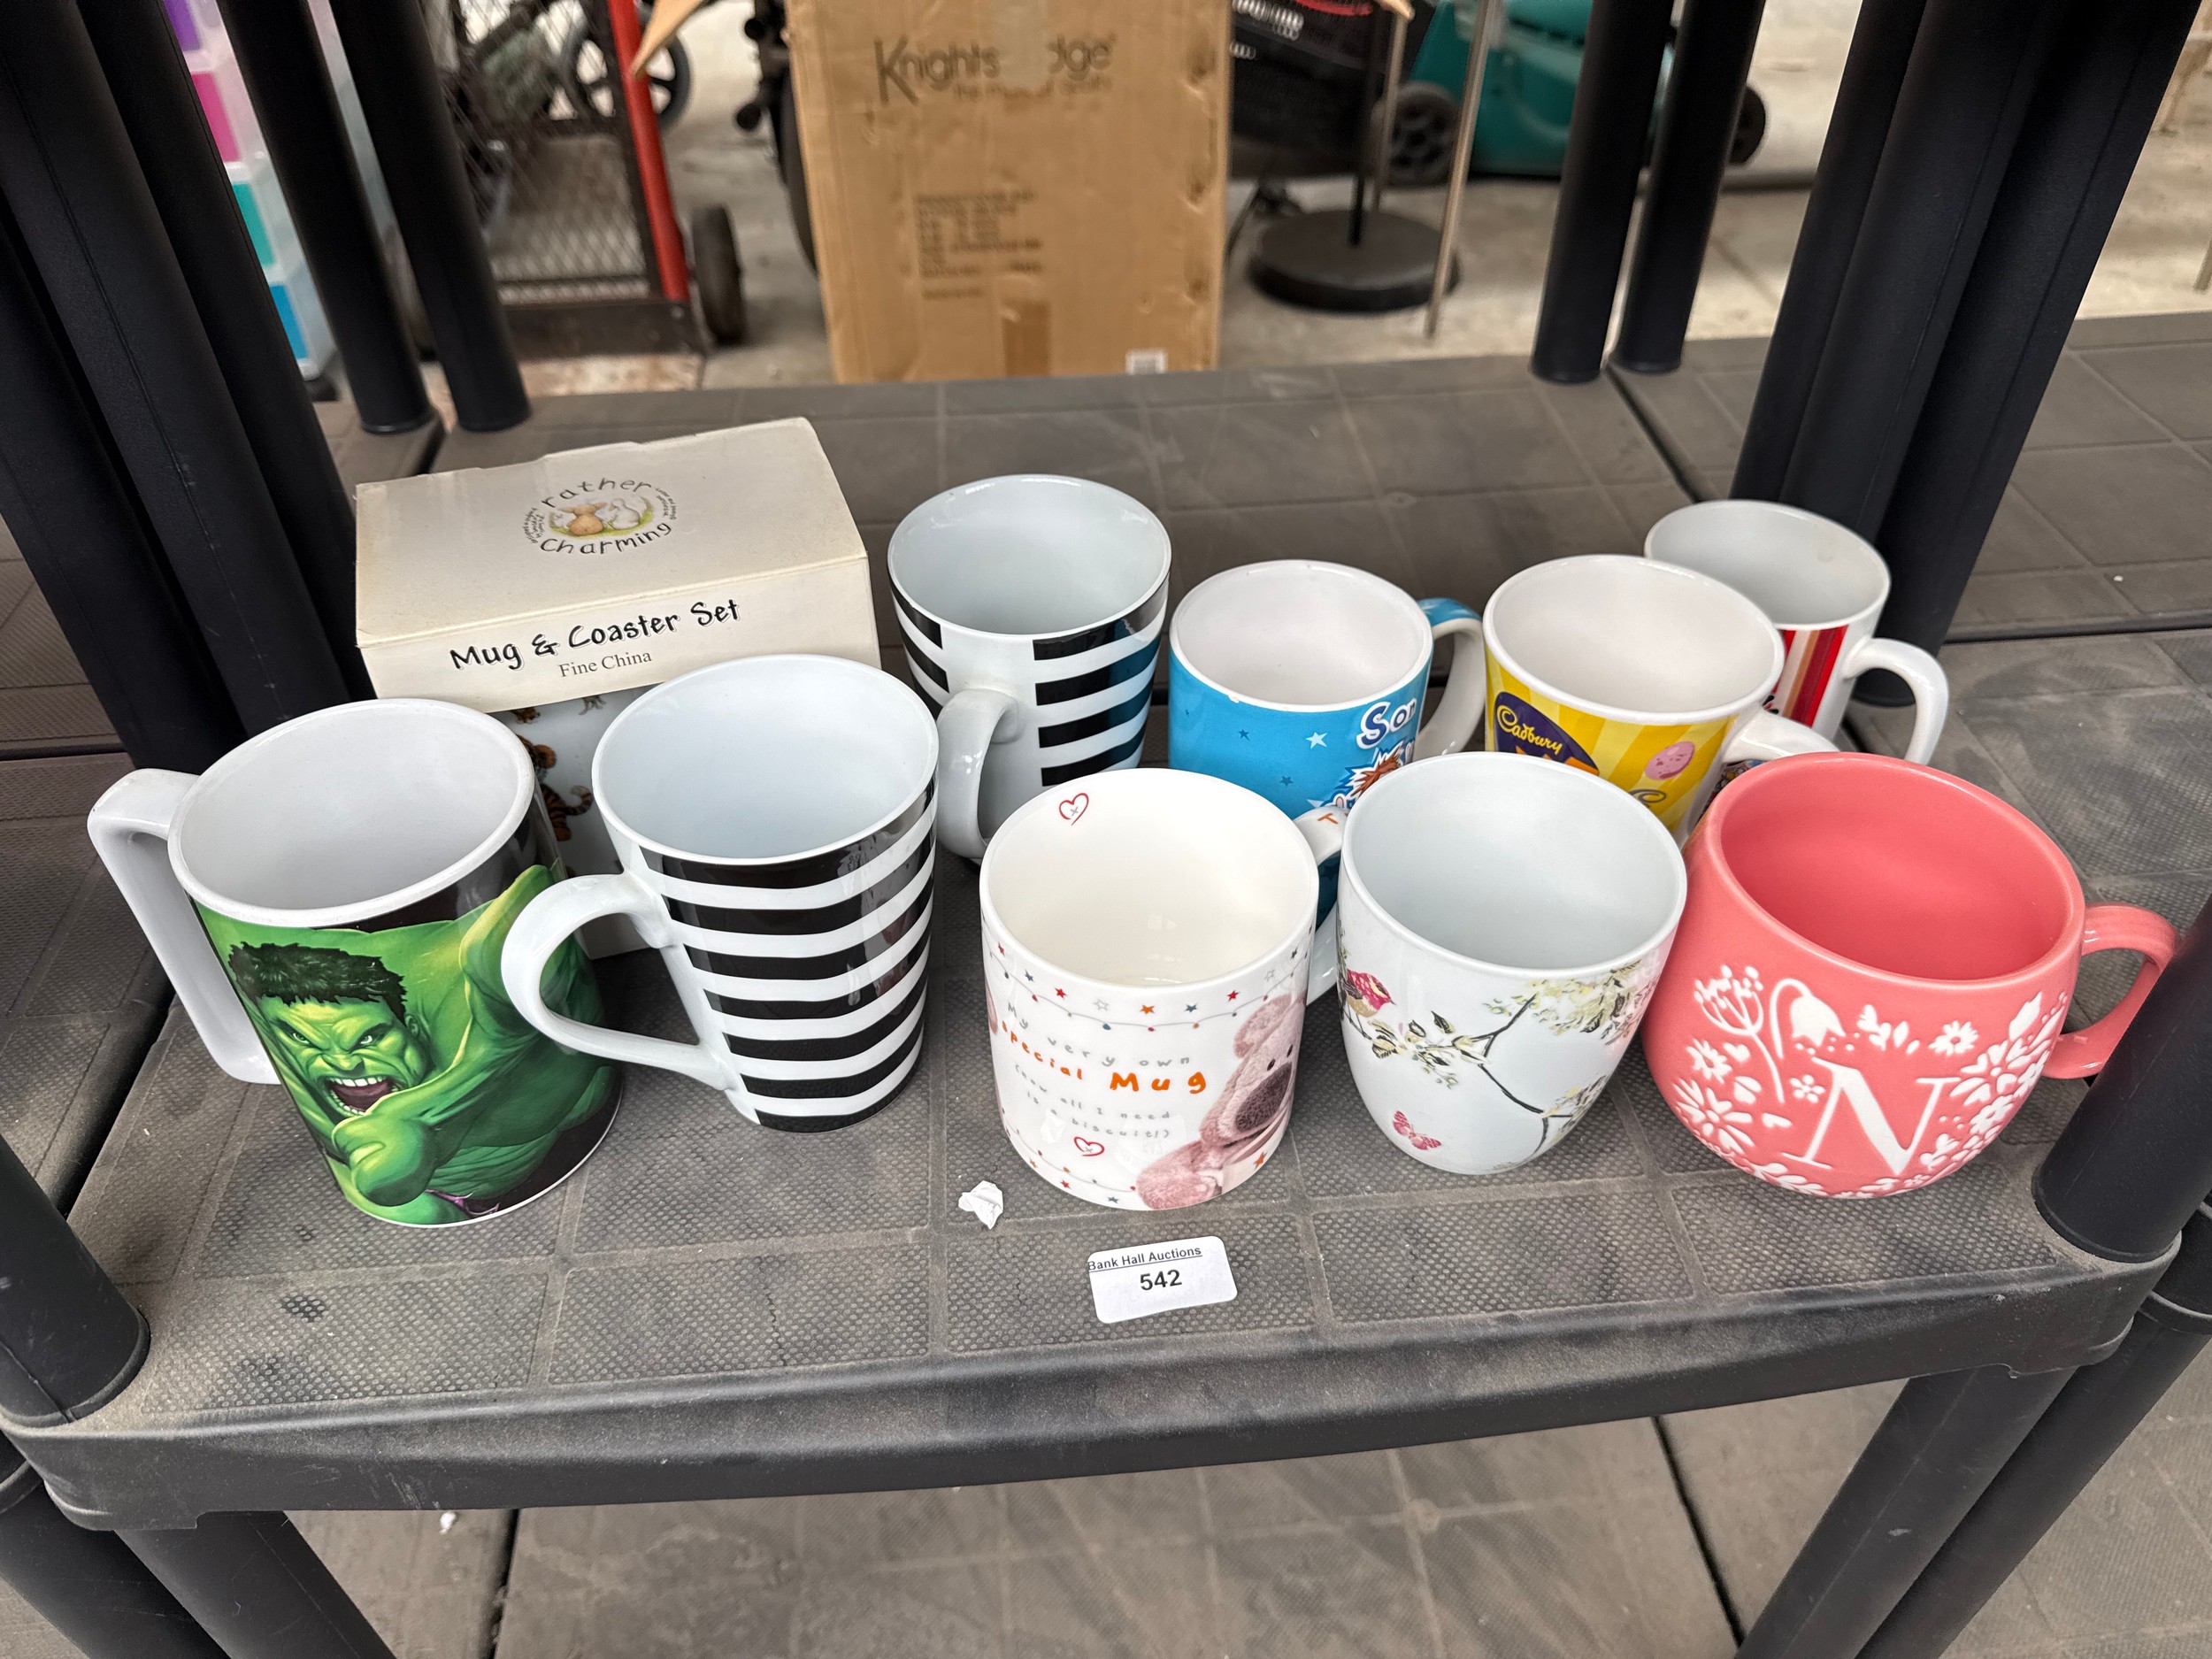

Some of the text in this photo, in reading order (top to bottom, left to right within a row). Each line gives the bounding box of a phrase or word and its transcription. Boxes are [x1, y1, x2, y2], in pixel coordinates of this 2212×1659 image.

[873, 35, 1116, 105] Knightsdge
[541, 478, 651, 508] rather
[541, 523, 672, 555] Charming
[449, 599, 740, 670] Mug & Coaster Set
[559, 650, 652, 678] Fine China
[1497, 705, 1563, 755] Cadbury
[1008, 1001, 1190, 1067] My very own
[1110, 1071, 1206, 1094] Mug
[1061, 1097, 1082, 1110] all
[1782, 1057, 1962, 1175] N
[1088, 1247, 1202, 1271] Bank Hall Auctions
[1140, 1269, 1183, 1291] 542
